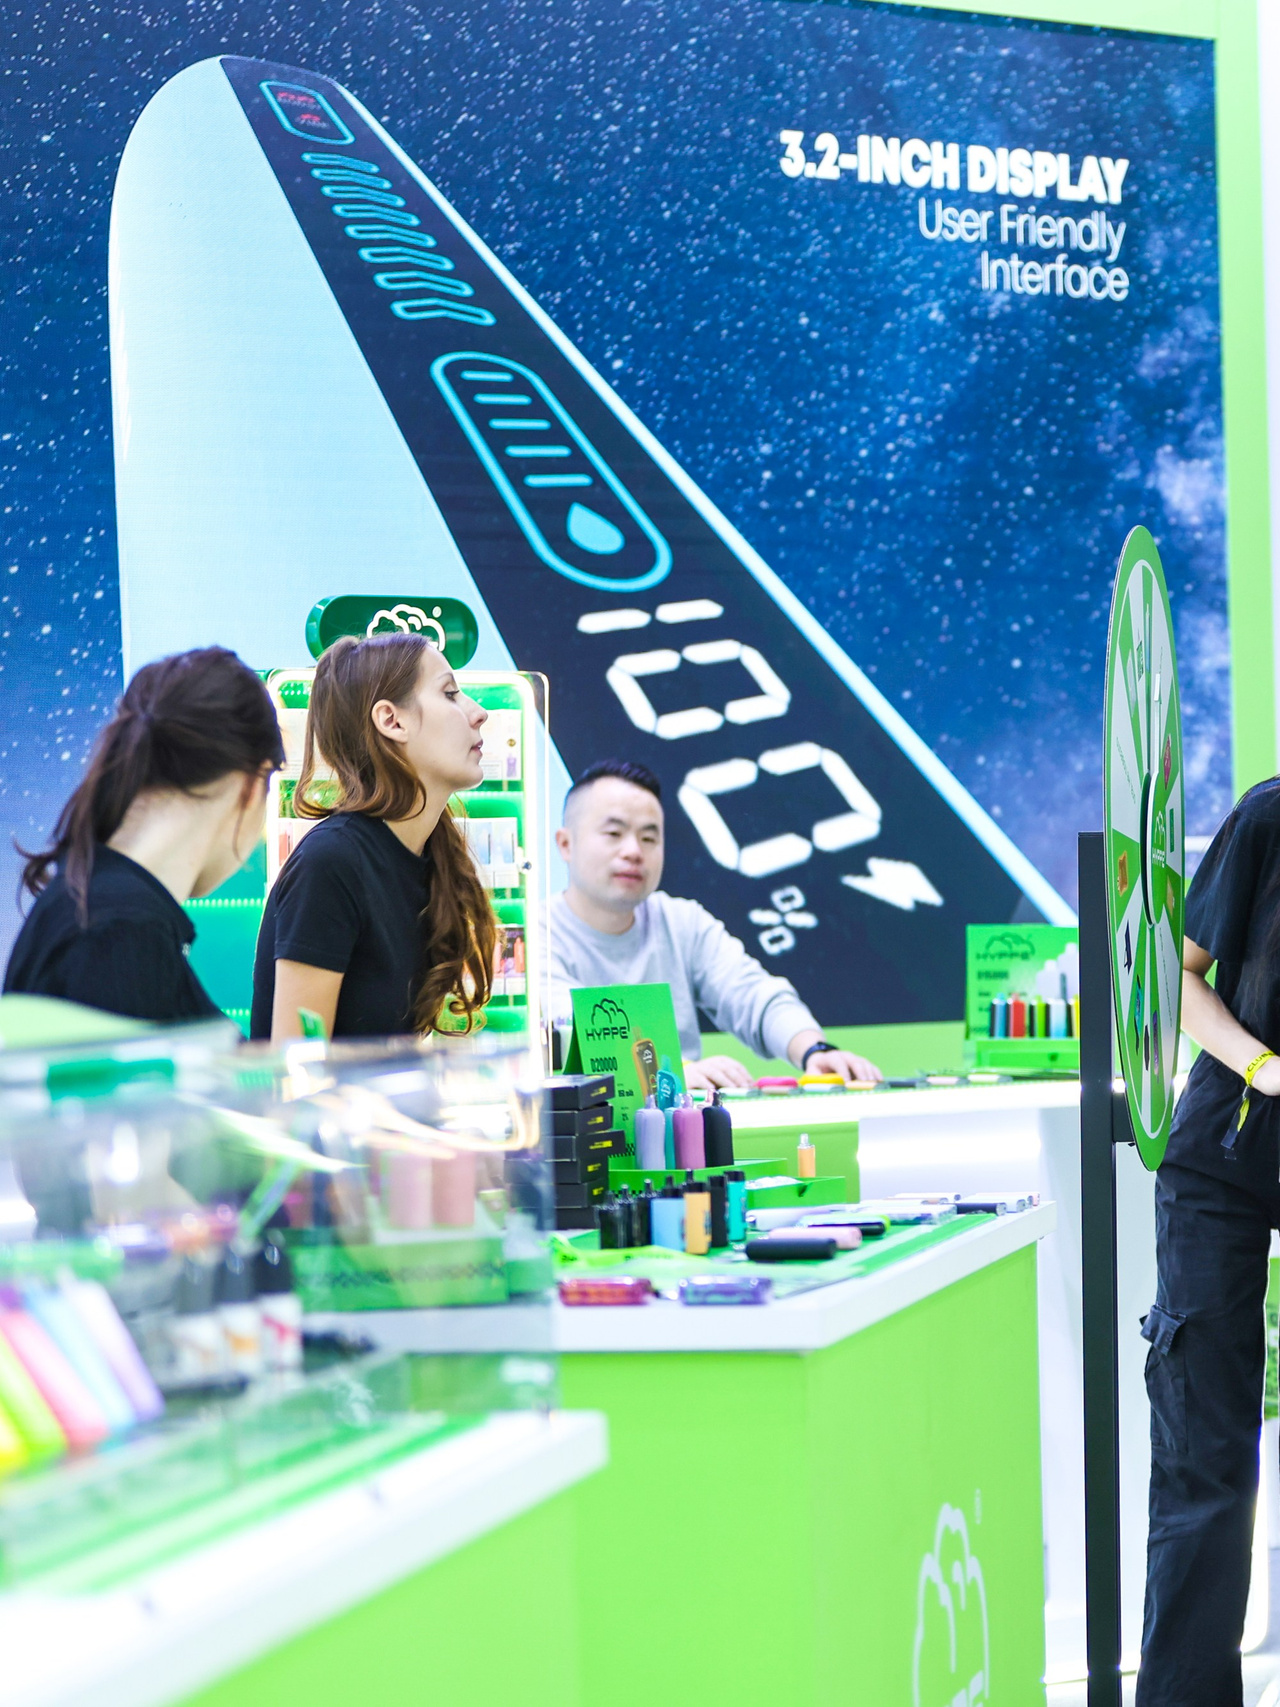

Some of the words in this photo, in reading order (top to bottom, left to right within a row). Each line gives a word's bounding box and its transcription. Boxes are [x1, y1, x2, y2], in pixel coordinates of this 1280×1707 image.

[779, 129, 960, 191] 3.2-INCH
[966, 144, 1130, 205] DISPLAY
[918, 197, 994, 242] User
[1000, 203, 1126, 263] Friendly
[981, 250, 1130, 301] Interface
[585, 1026, 629, 1041] HYPPE
